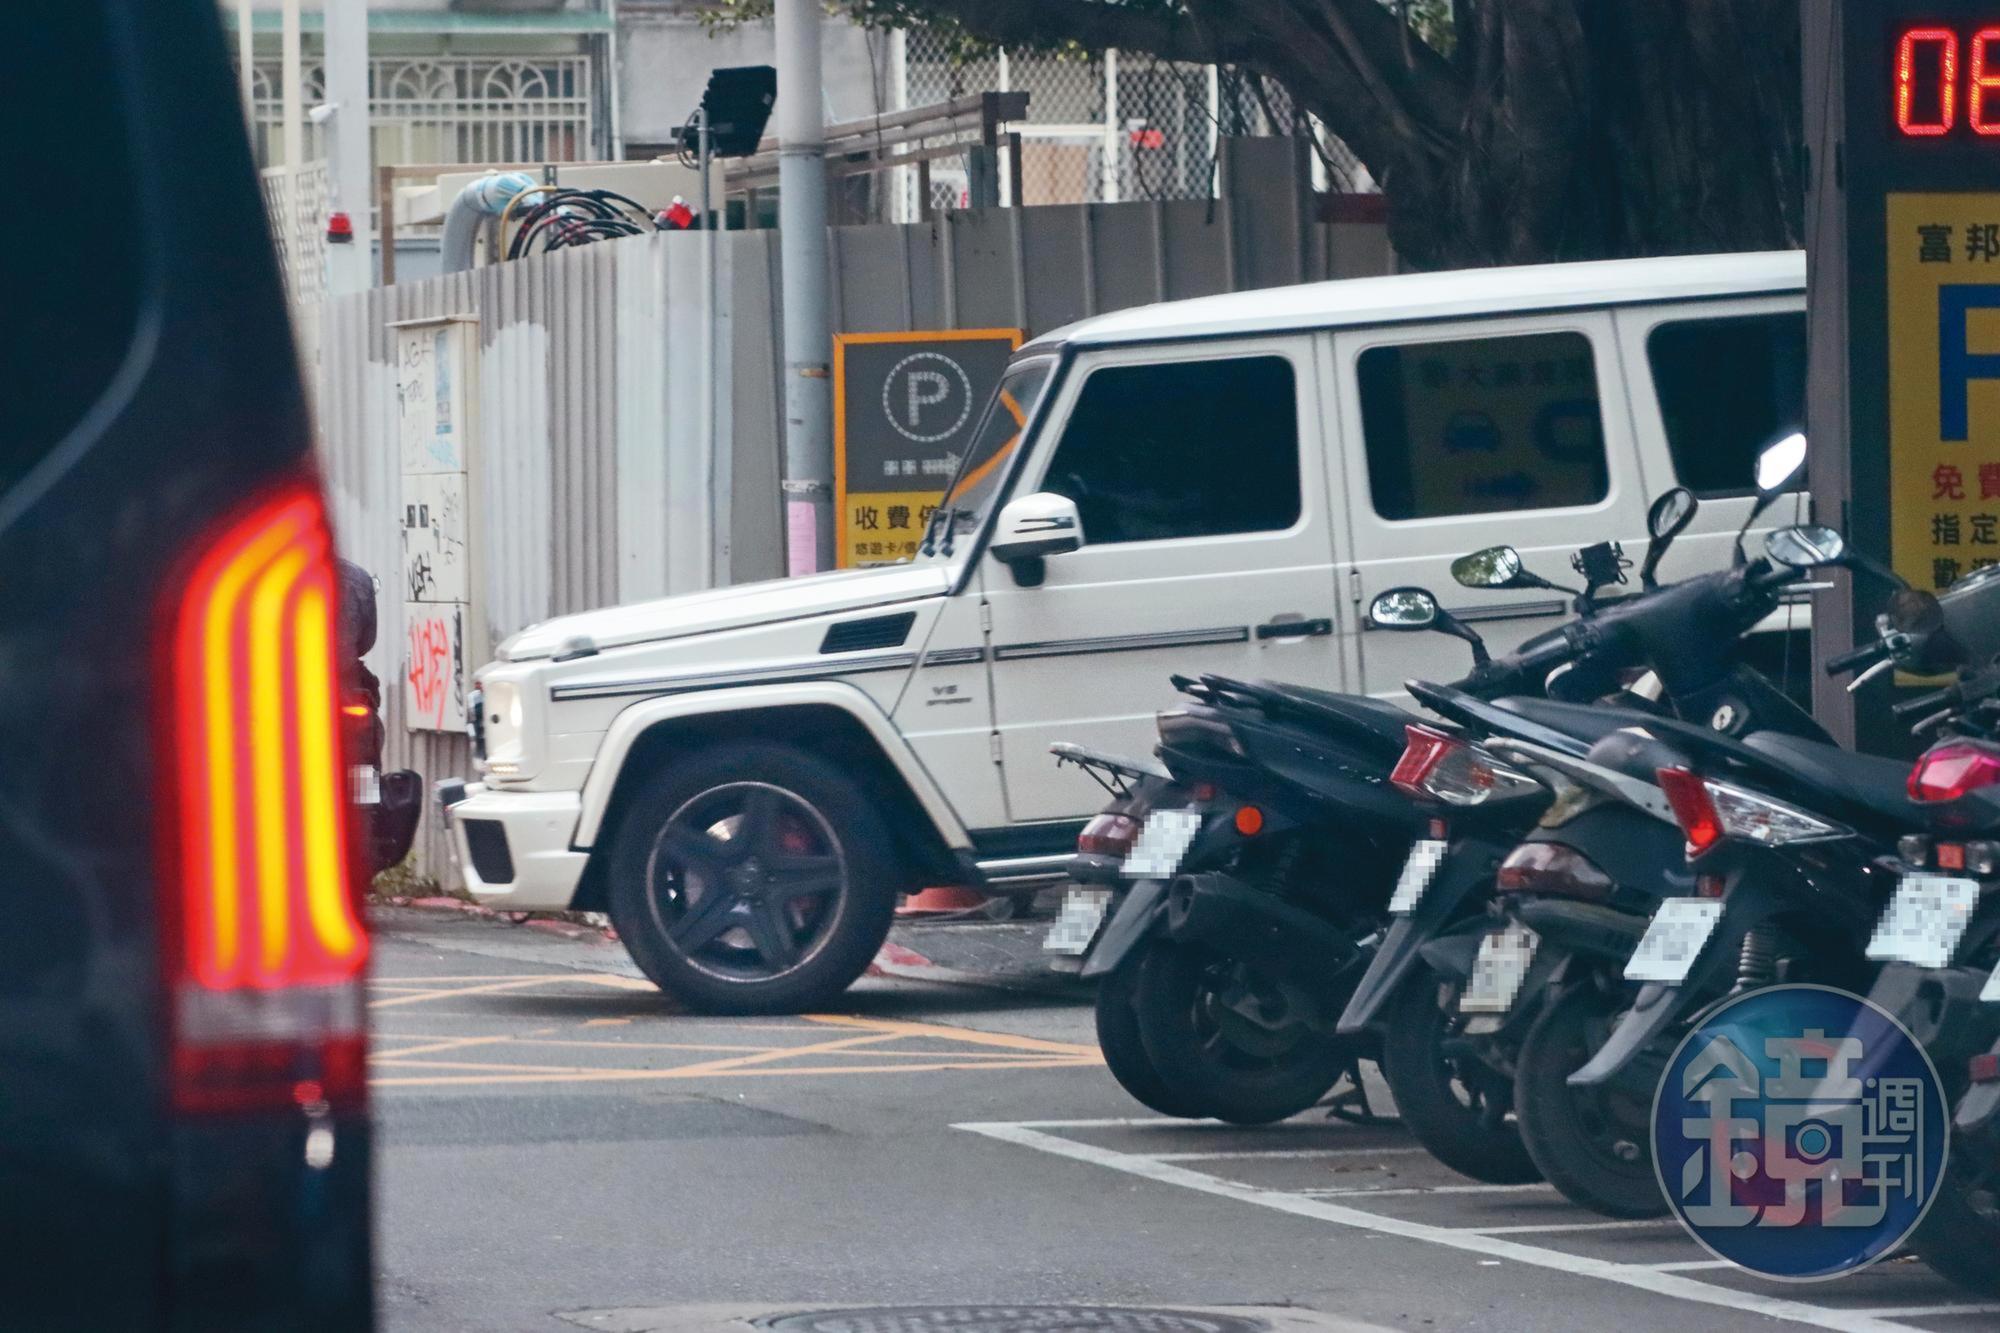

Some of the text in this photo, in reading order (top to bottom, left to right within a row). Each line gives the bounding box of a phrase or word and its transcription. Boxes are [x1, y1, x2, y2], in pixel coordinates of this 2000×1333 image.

[1917, 224, 2000, 264] 富邦
[907, 370, 950, 427] P
[1932, 462, 2000, 501] 免費
[1931, 513, 2000, 547] 指定
